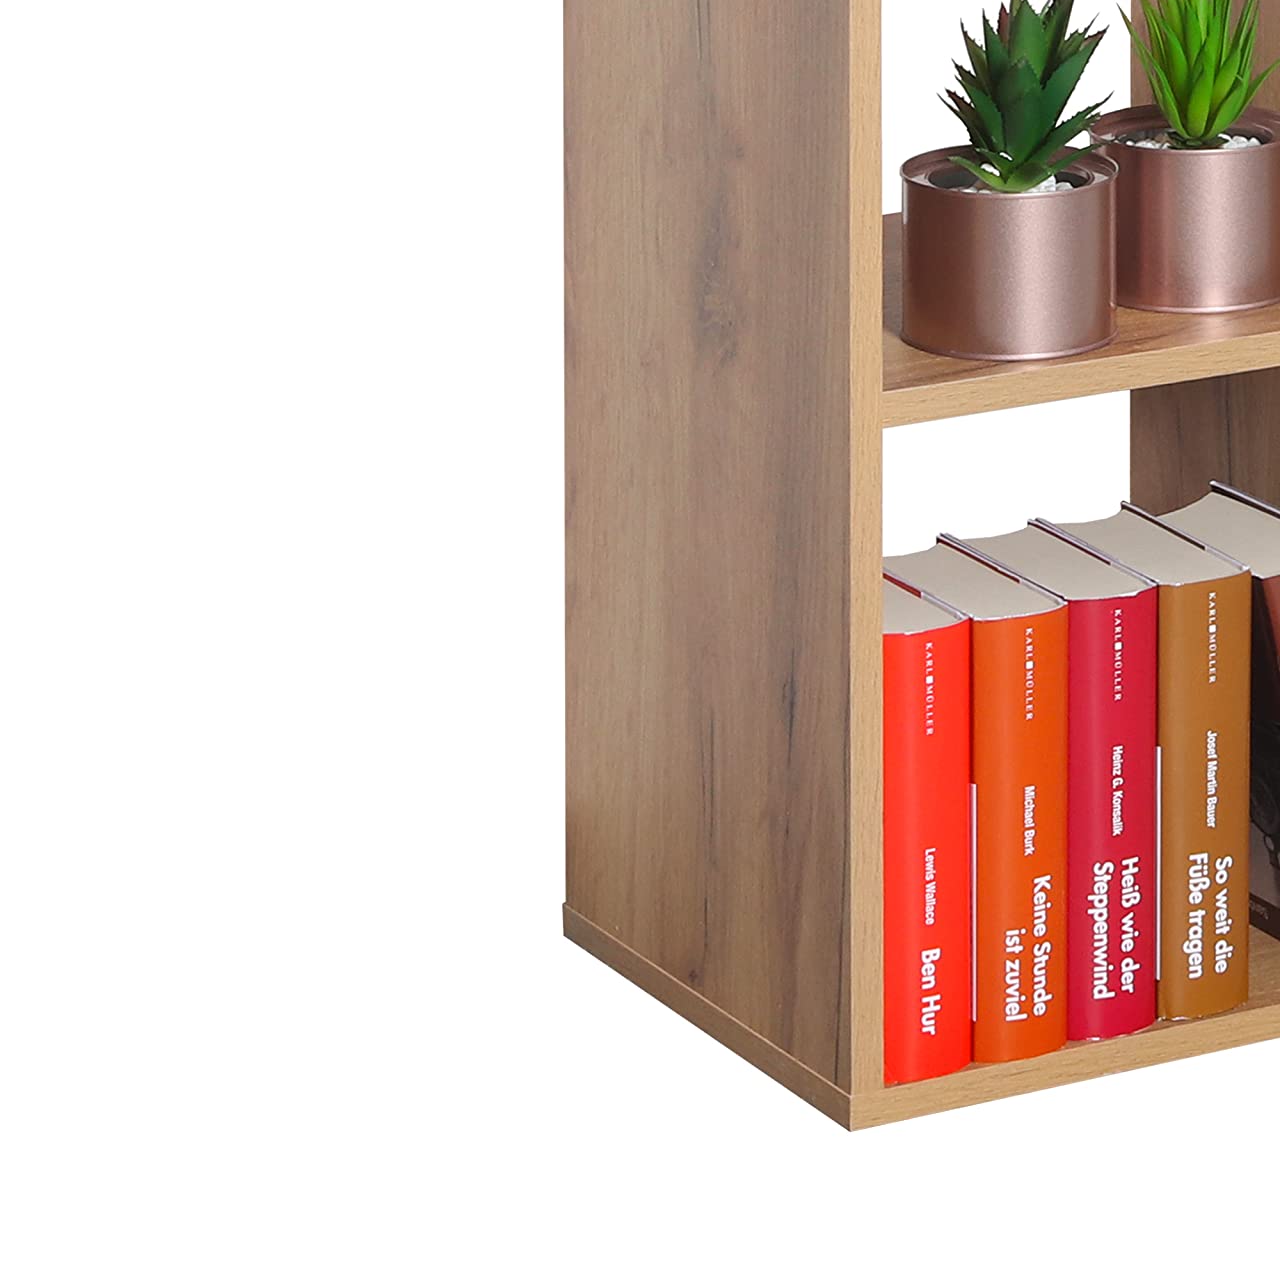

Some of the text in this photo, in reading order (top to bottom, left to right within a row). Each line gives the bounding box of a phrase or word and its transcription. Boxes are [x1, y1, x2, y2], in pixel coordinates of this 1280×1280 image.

[1025, 627, 1034, 720] KARL MÜLLER
[1114, 609, 1123, 701] KARL MÜLLER
[1208, 592, 1217, 683] KARL MÜLLER
[925, 642, 934, 736] KARL MÜLLER
[1023, 785, 1036, 856] Michael Burk
[1112, 745, 1124, 837] Heinz G. Konsalik
[1206, 730, 1218, 828] Josef Martin Bauer
[924, 847, 937, 926] Lewis Wallace
[1088, 861, 1115, 1000] Steppenwind
[1120, 856, 1141, 994] Heiß wie der
[1184, 852, 1210, 979] Füße tragen
[1214, 855, 1234, 974] So weit die
[920, 947, 941, 1036] Ben Hur
[1004, 928, 1028, 1022] ist zuviel
[1033, 874, 1052, 1017] Keine Stunde
